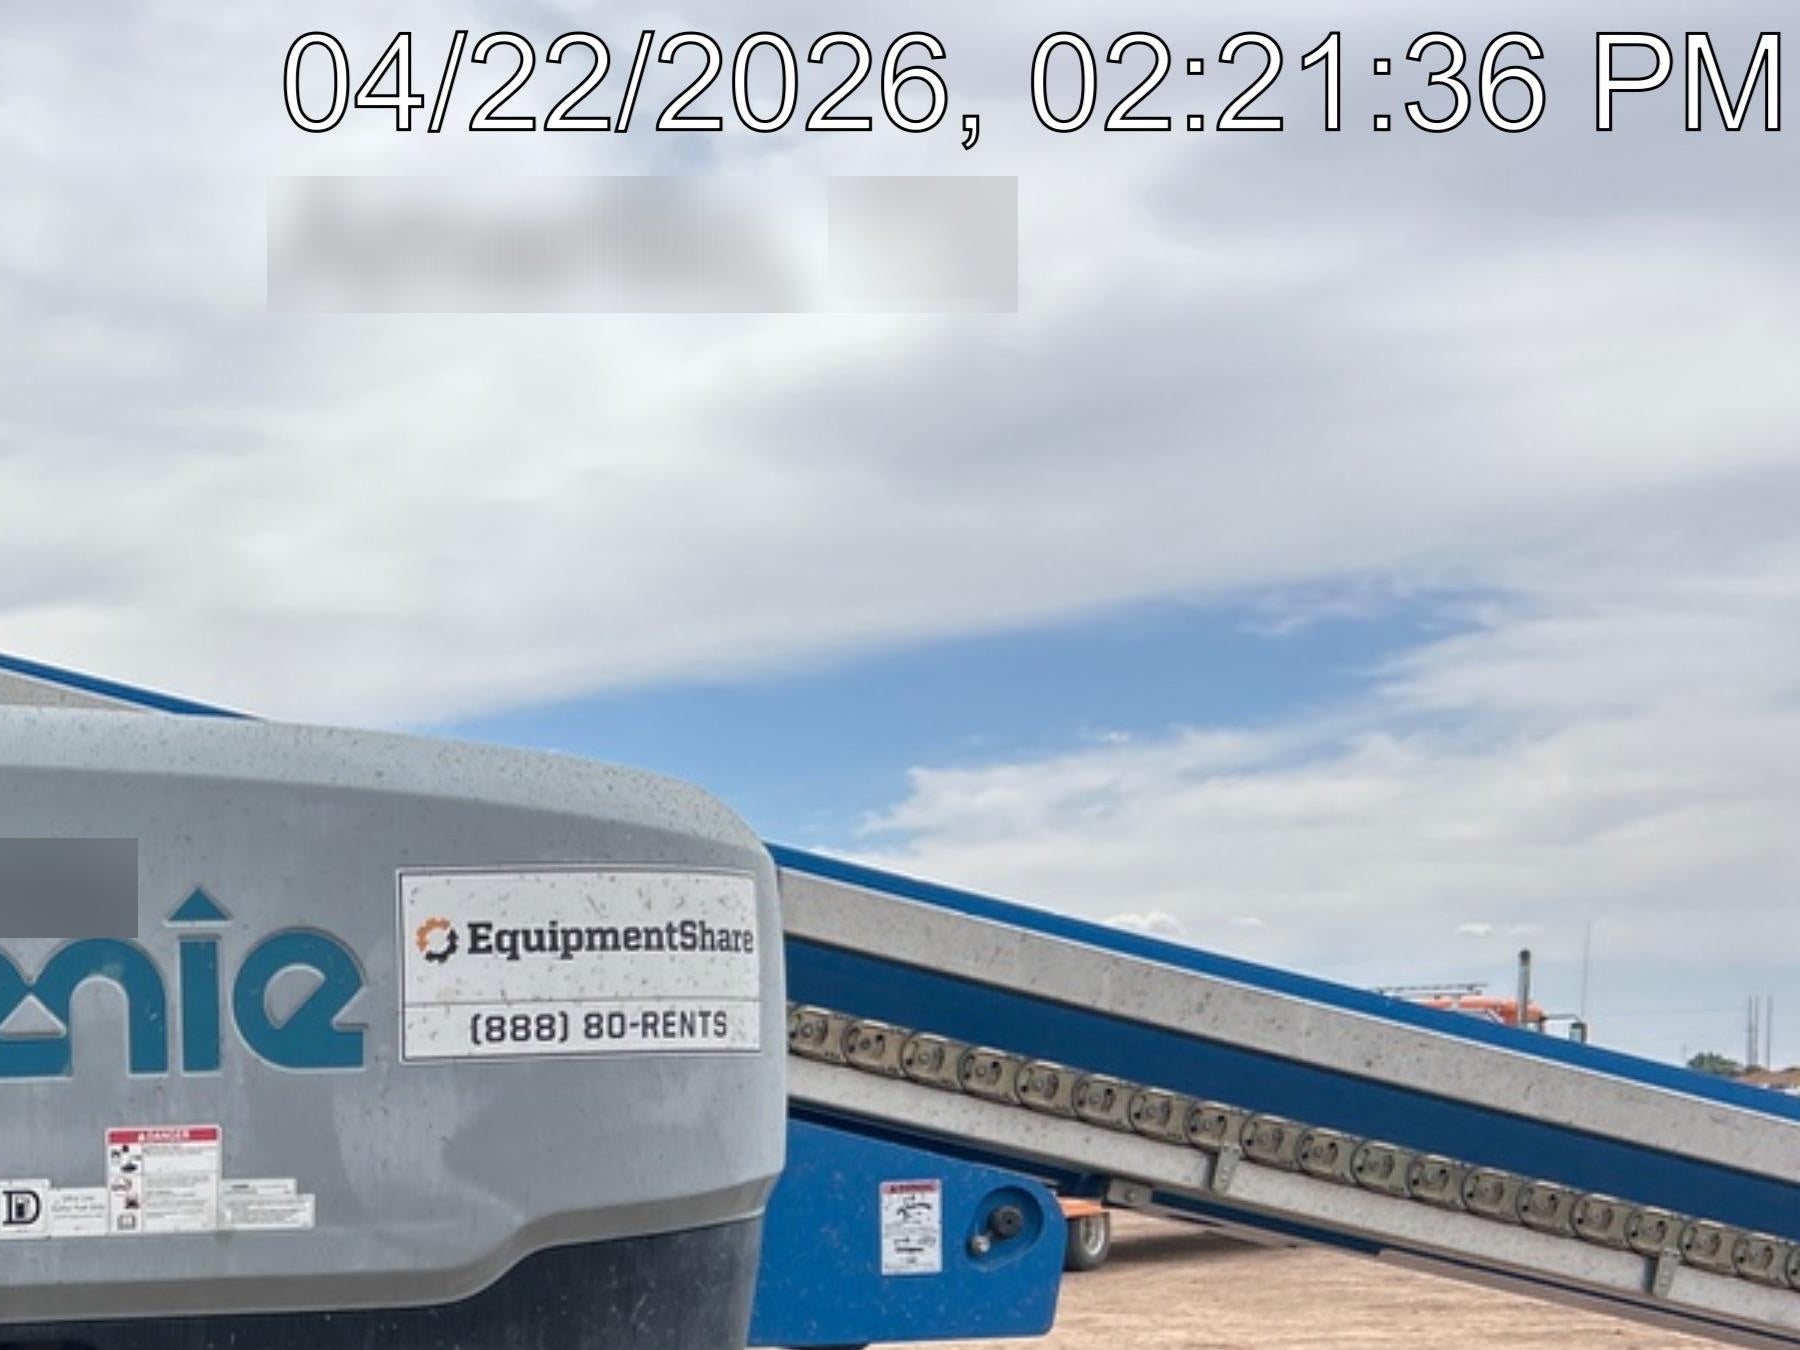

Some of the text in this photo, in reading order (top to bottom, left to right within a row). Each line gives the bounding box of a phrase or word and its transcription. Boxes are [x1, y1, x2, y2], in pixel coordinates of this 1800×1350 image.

[467, 920, 755, 961] EquipmentShare
[470, 1009, 728, 1045] (888) 80-RENTS
